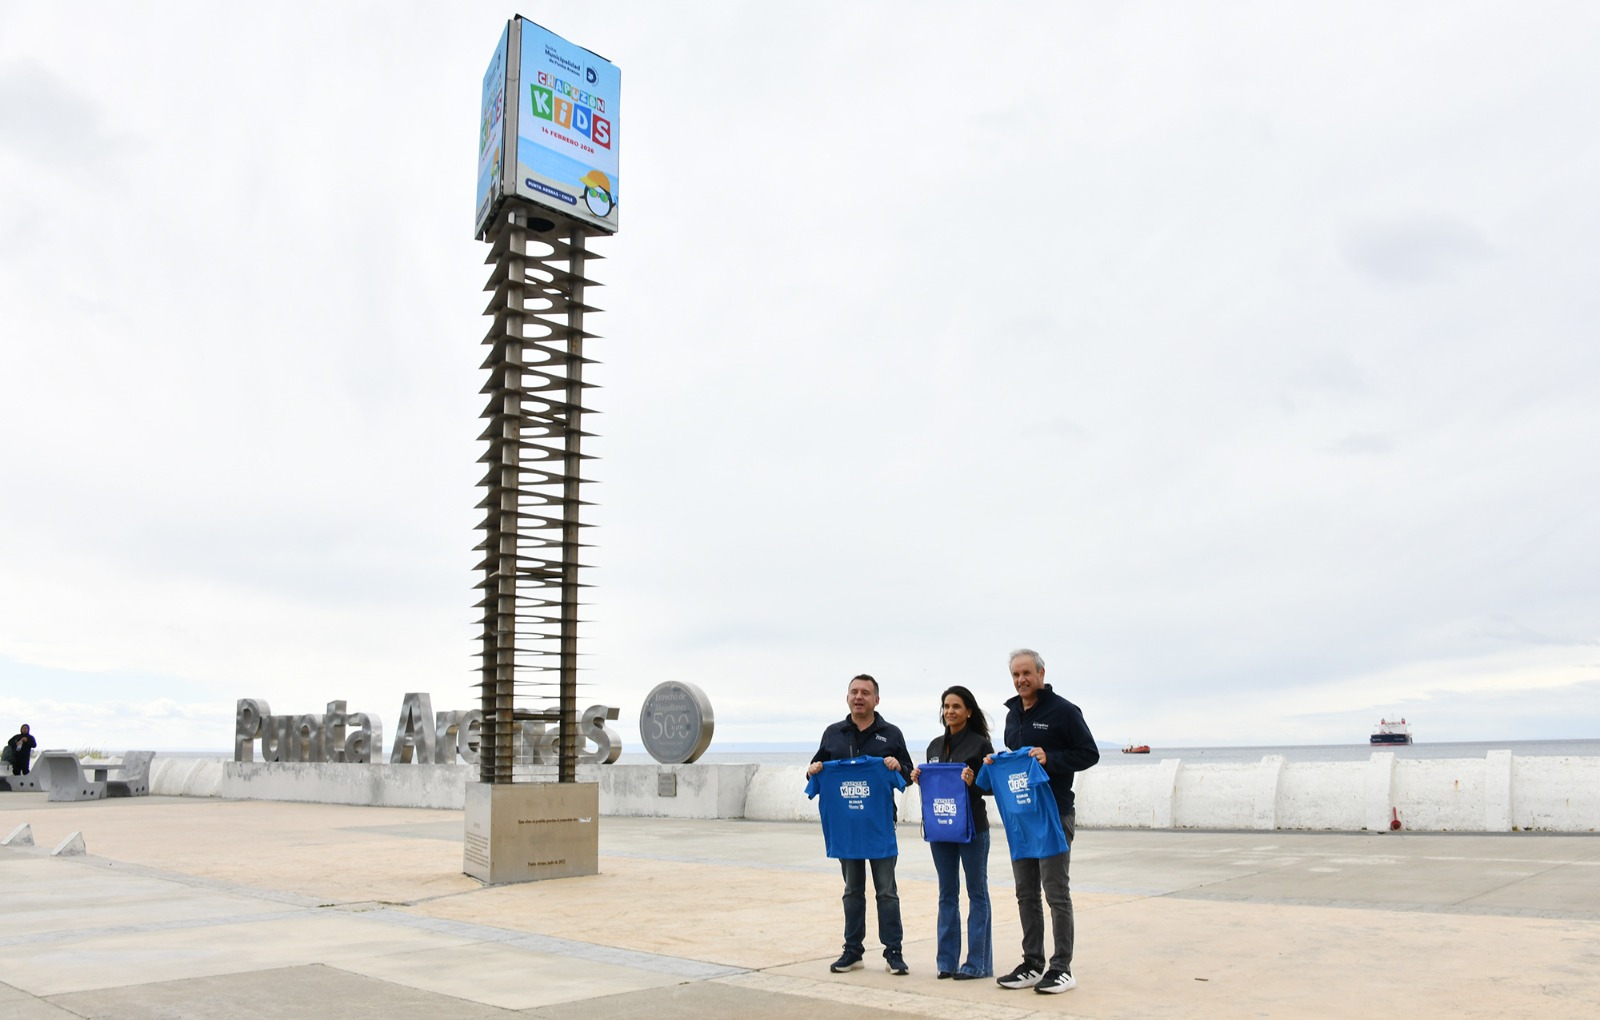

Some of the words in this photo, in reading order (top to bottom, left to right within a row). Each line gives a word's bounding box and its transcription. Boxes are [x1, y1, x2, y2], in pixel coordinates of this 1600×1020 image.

[541, 126, 549, 134] 14
[550, 130, 579, 147] FEBRERO
[580, 143, 595, 154] 2026
[235, 698, 382, 763] Punta
